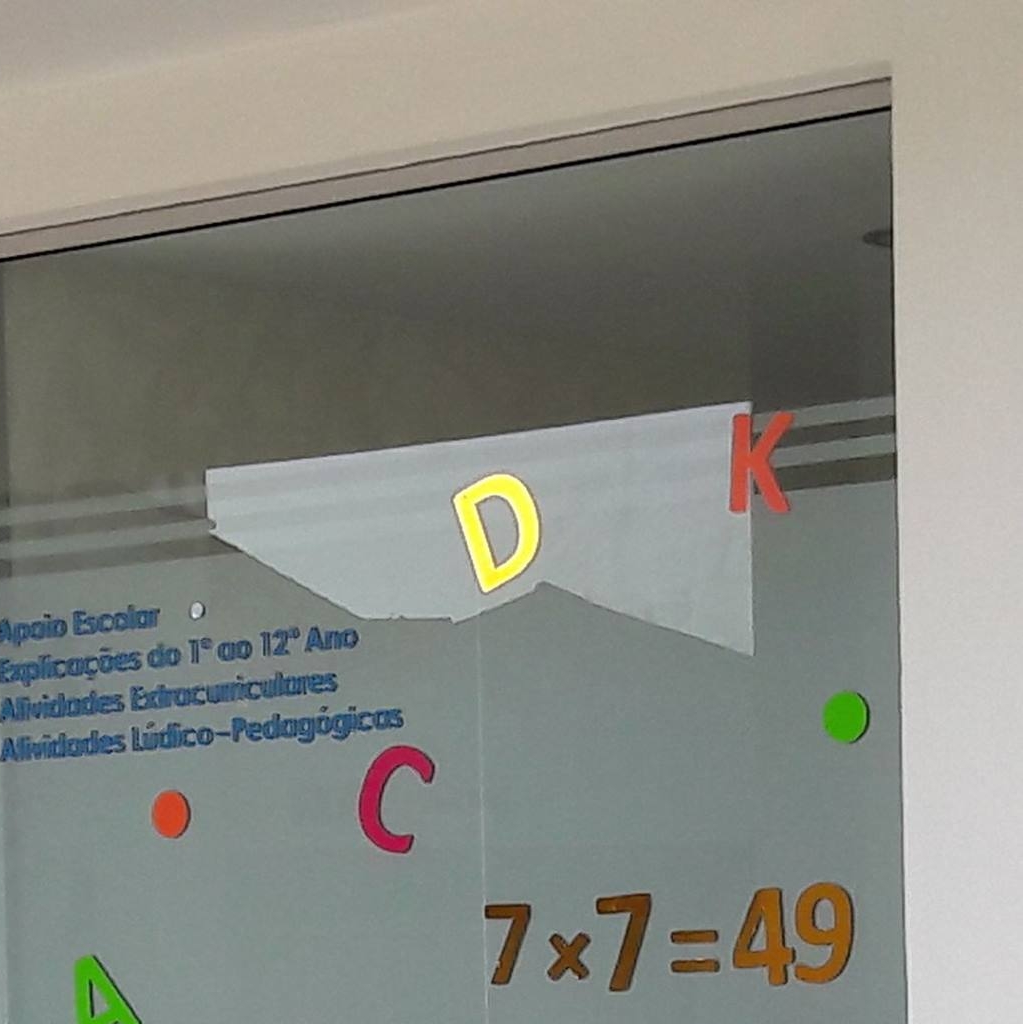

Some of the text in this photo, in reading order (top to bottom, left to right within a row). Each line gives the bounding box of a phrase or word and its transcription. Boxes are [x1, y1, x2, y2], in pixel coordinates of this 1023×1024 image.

[729, 411, 796, 514] K
[453, 473, 542, 593] D
[72, 605, 160, 636] Escolar
[147, 643, 181, 669] do
[217, 639, 253, 662] ao
[305, 626, 359, 652] Ano
[0, 672, 338, 722] Atividades Extracurriculares
[0, 705, 405, 763] Atividades Lúdico-Pedagógicos
[358, 745, 435, 854] C
